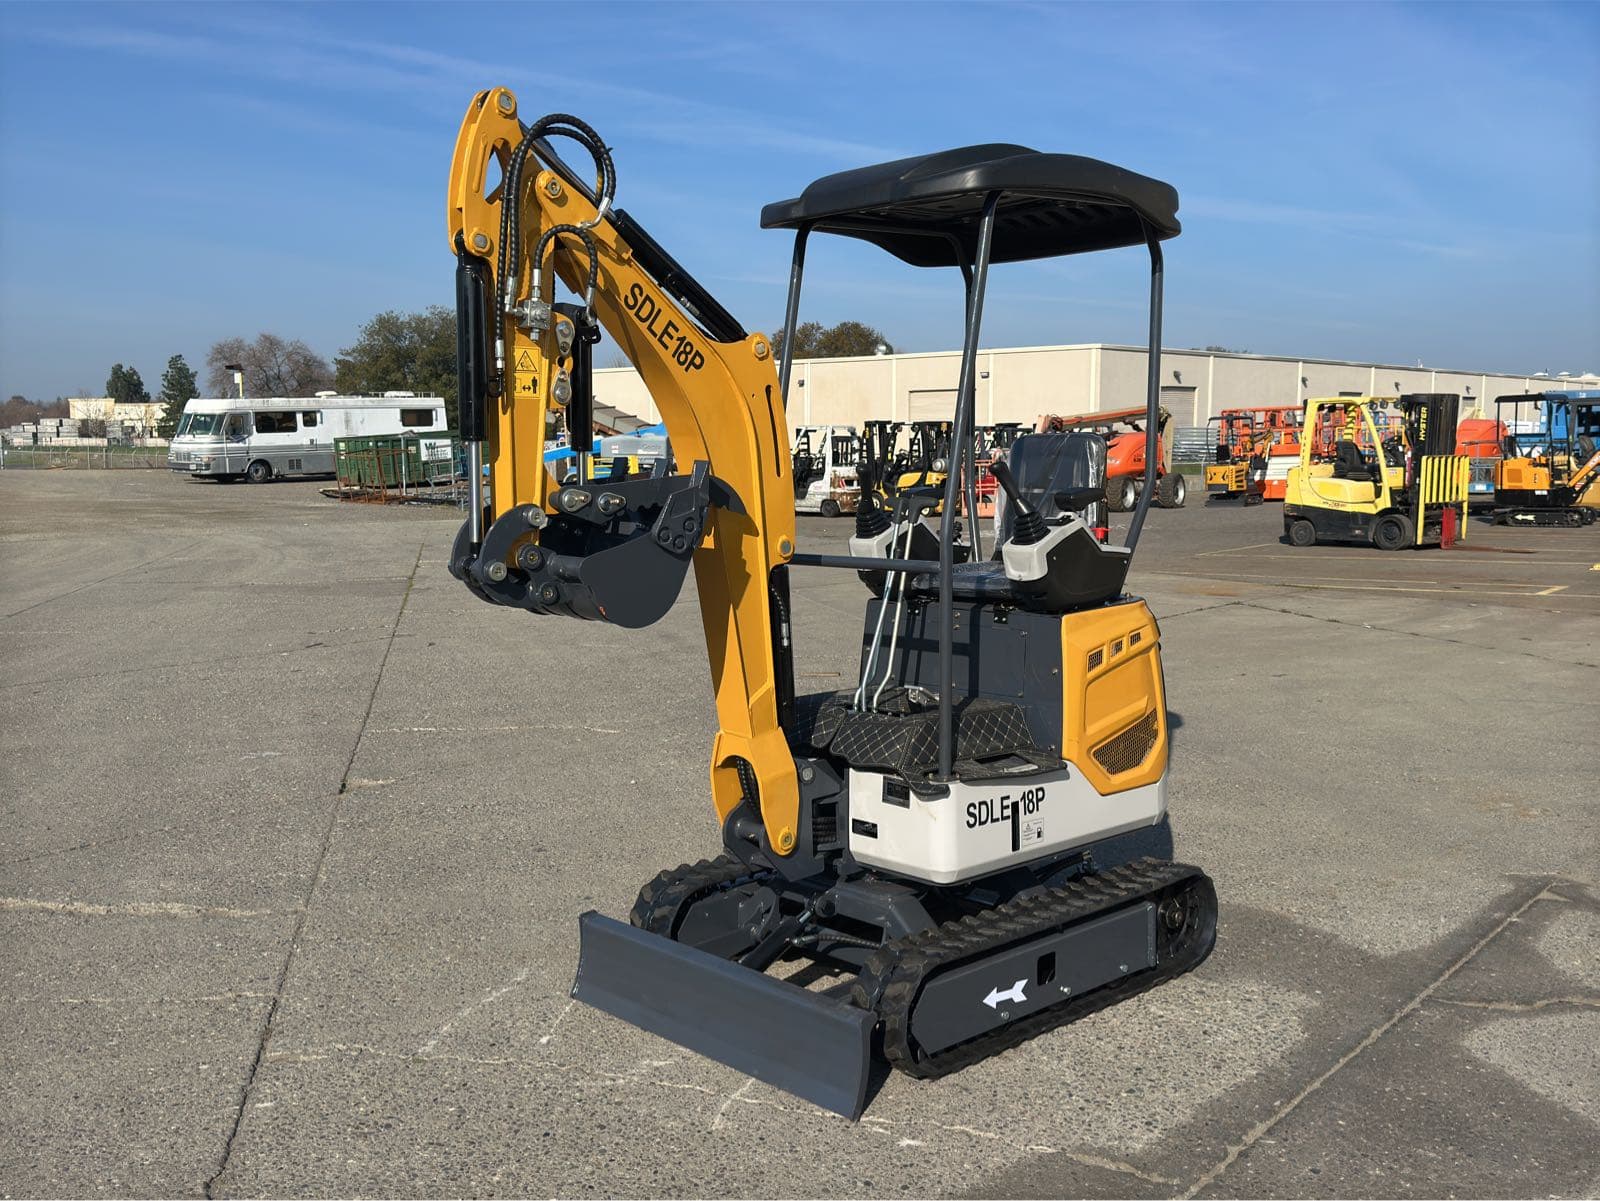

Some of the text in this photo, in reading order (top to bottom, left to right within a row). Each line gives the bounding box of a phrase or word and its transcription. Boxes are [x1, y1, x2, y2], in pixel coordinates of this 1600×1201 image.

[623, 282, 705, 373] SDLE18P
[1419, 406, 1428, 441] HYSTER
[966, 786, 1046, 829] SDLE 18P
